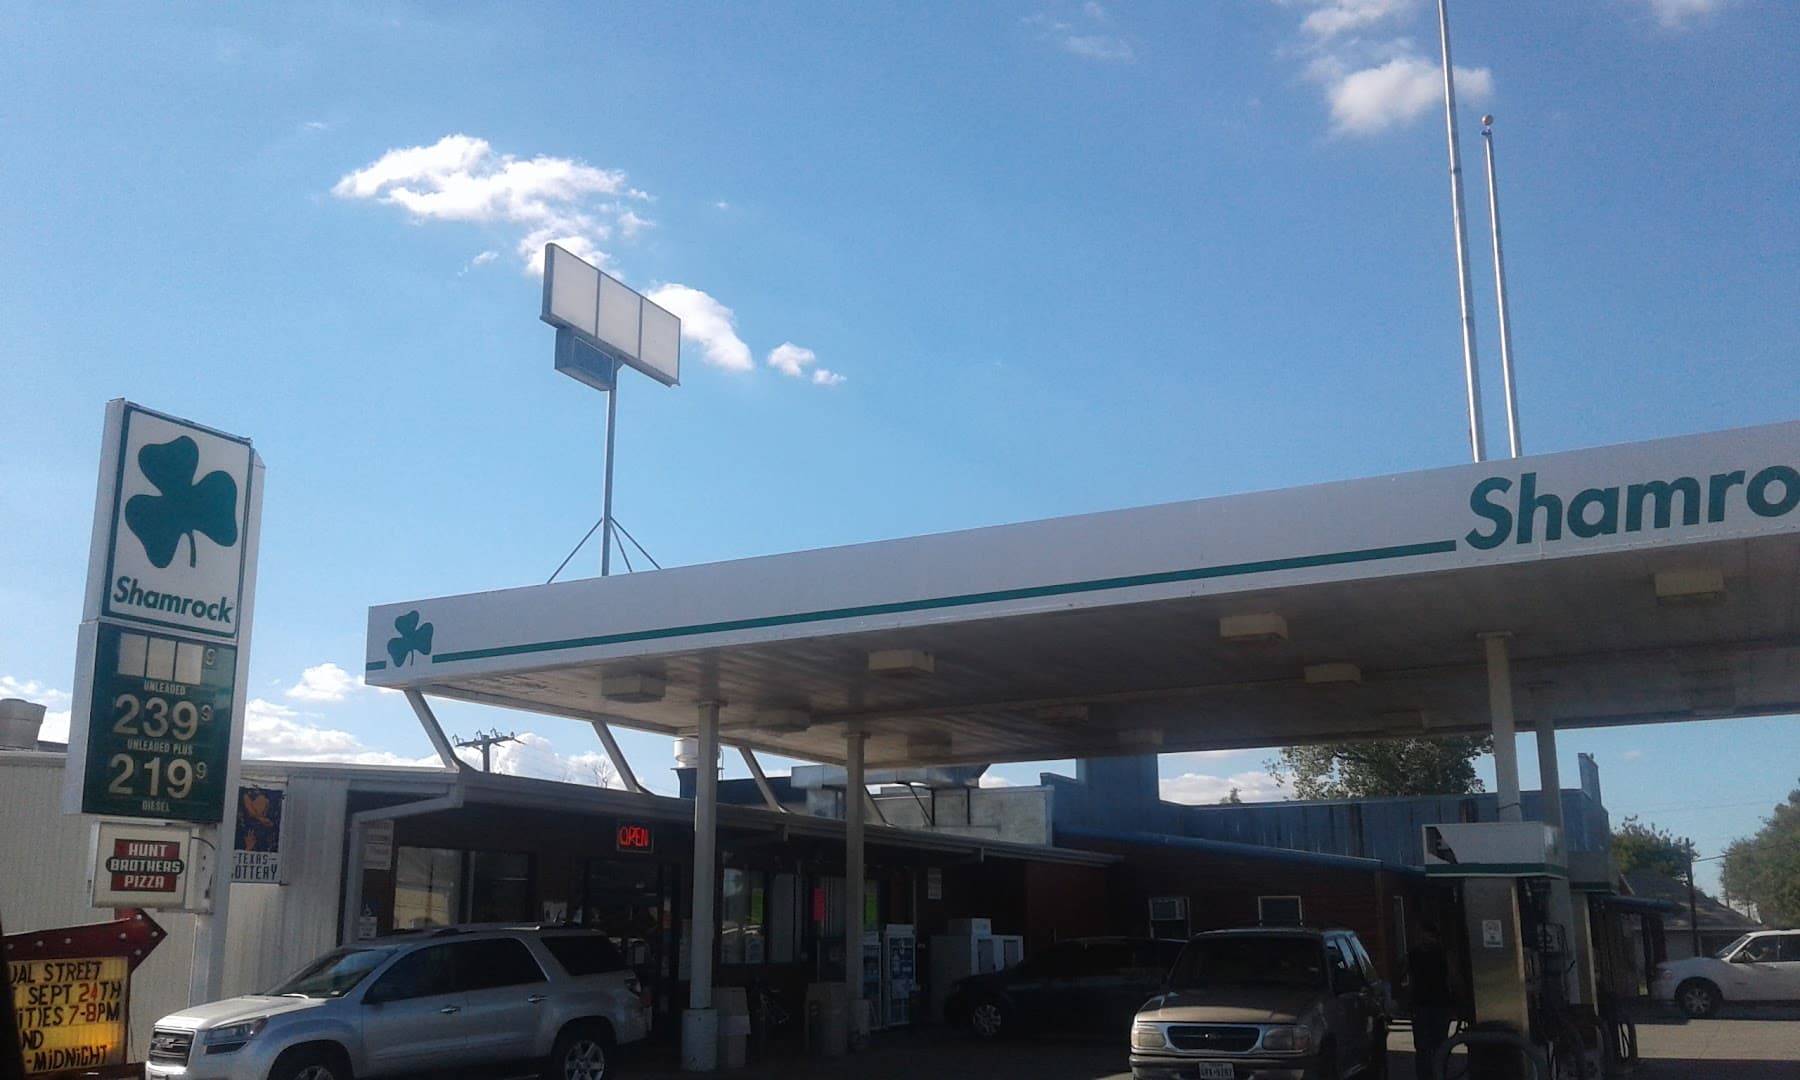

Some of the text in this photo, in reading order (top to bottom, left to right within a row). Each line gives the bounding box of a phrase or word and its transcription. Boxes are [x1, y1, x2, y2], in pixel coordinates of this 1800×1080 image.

[113, 575, 235, 623] Shamrock
[143, 680, 186, 696] UNLEADED
[127, 739, 193, 756] UNLEADED PLUS
[142, 800, 170, 813] DIESEL
[617, 826, 648, 847] OPEN
[128, 842, 168, 857] HUNT
[110, 858, 181, 873] BROTHERS
[231, 864, 277, 880] OTTERY
[124, 875, 165, 889] PIZZA
[44, 961, 102, 982] STREET
[28, 984, 73, 1005] SEPT
